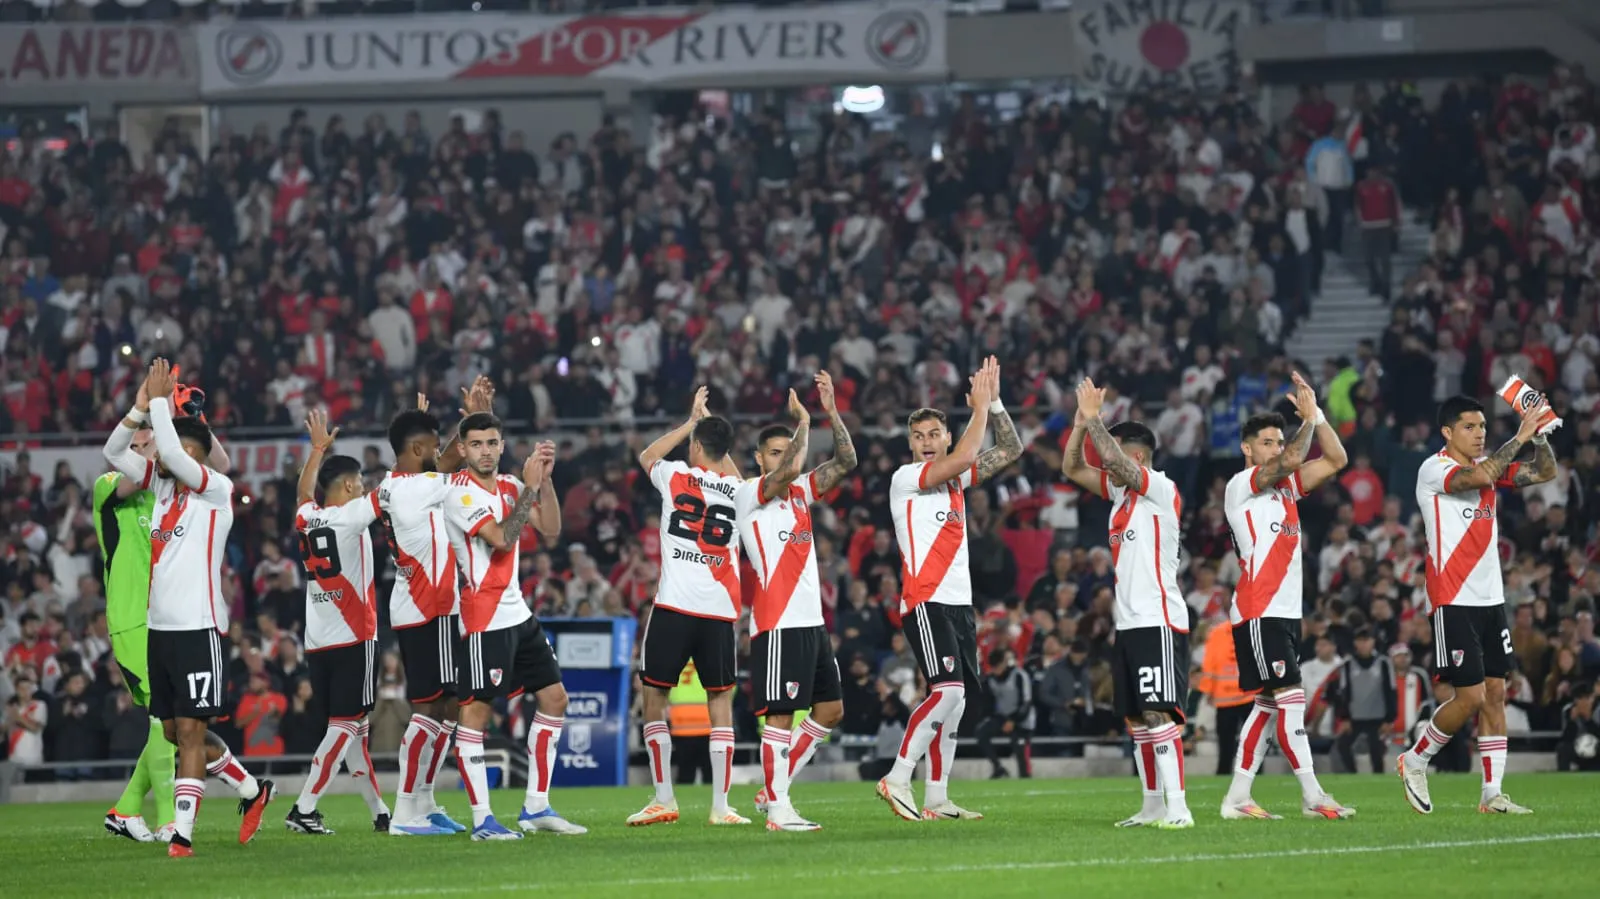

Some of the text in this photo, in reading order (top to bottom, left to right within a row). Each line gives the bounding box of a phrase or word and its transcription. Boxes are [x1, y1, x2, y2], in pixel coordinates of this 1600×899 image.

[0, 27, 188, 80] ANEDA
[297, 19, 847, 71] JUNTOS POR RIVER
[667, 492, 736, 547] 26
[672, 547, 723, 567] DIRECTV
[187, 671, 212, 699] 17
[1138, 666, 1162, 694] 21
[559, 754, 599, 768] TCL
